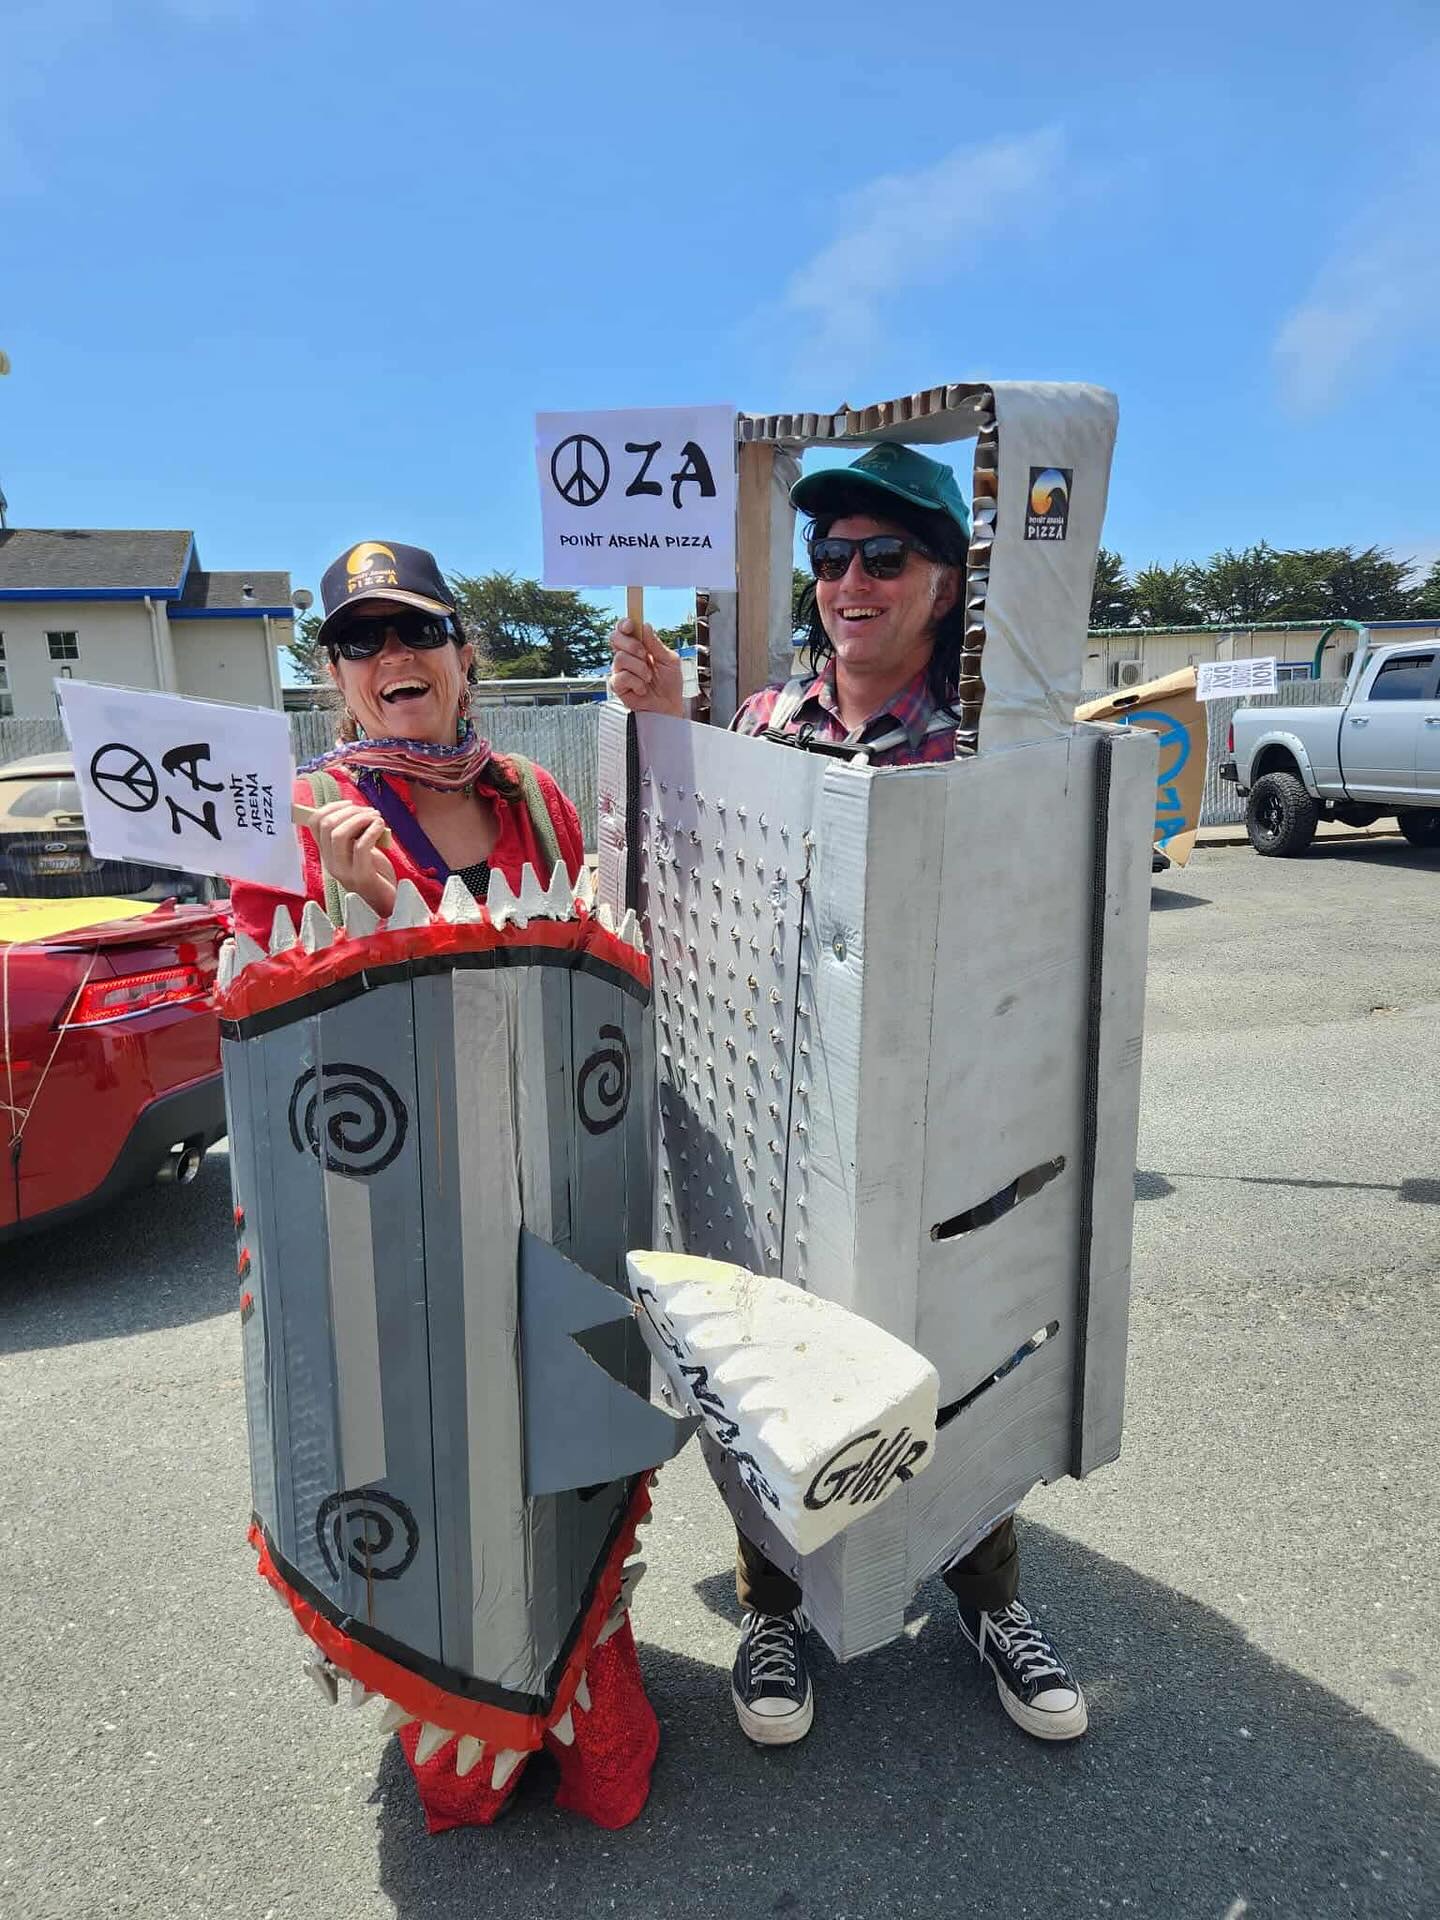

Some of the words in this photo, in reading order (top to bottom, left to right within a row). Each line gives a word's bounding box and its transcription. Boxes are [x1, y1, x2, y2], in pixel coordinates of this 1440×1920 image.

[624, 441, 717, 509] ZA
[560, 533, 603, 547] POINT
[608, 533, 660, 548] ARENA
[665, 535, 713, 549] PIZZA
[1028, 525, 1063, 540] PIZZA
[347, 574, 398, 593] PIZZA
[1211, 666, 1233, 688] DAY
[161, 743, 225, 840] ZA
[229, 774, 249, 828] POINT
[246, 773, 263, 832] ARENA
[261, 785, 276, 835] PIZZA
[803, 1426, 929, 1511] GNAR
